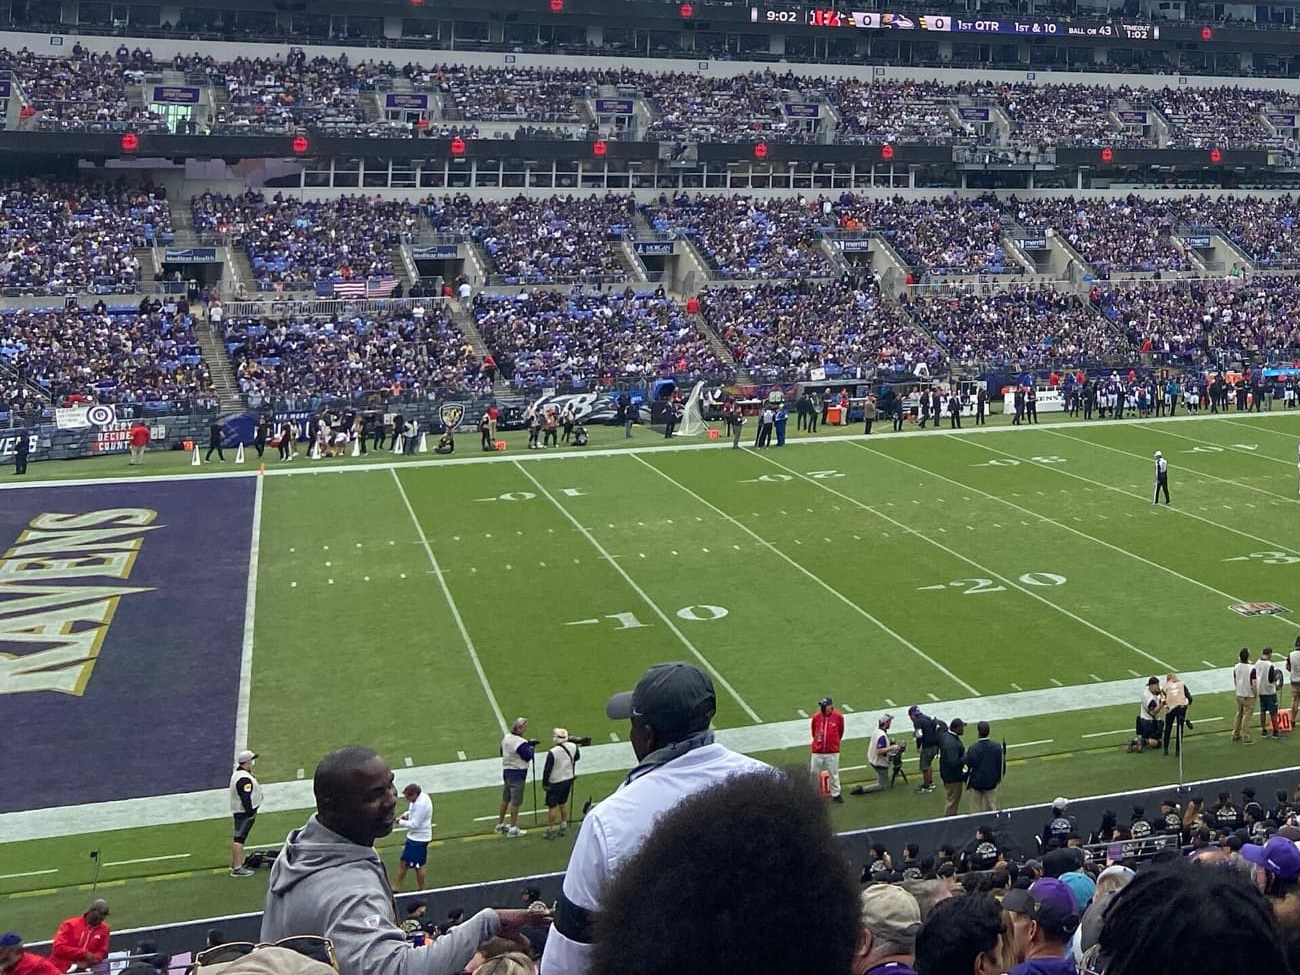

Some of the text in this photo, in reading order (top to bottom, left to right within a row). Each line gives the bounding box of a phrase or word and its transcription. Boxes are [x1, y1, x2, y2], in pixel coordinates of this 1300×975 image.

[767, 10, 797, 22] 9:02
[863, 15, 943, 29] 0 0
[957, 20, 999, 30] 1ST QTR
[1014, 22, 1056, 33] 1ST & 10
[1099, 25, 1111, 35] 43
[1127, 30, 1148, 39] 1:02
[949, 572, 1068, 594] 20
[605, 604, 729, 631] 10
